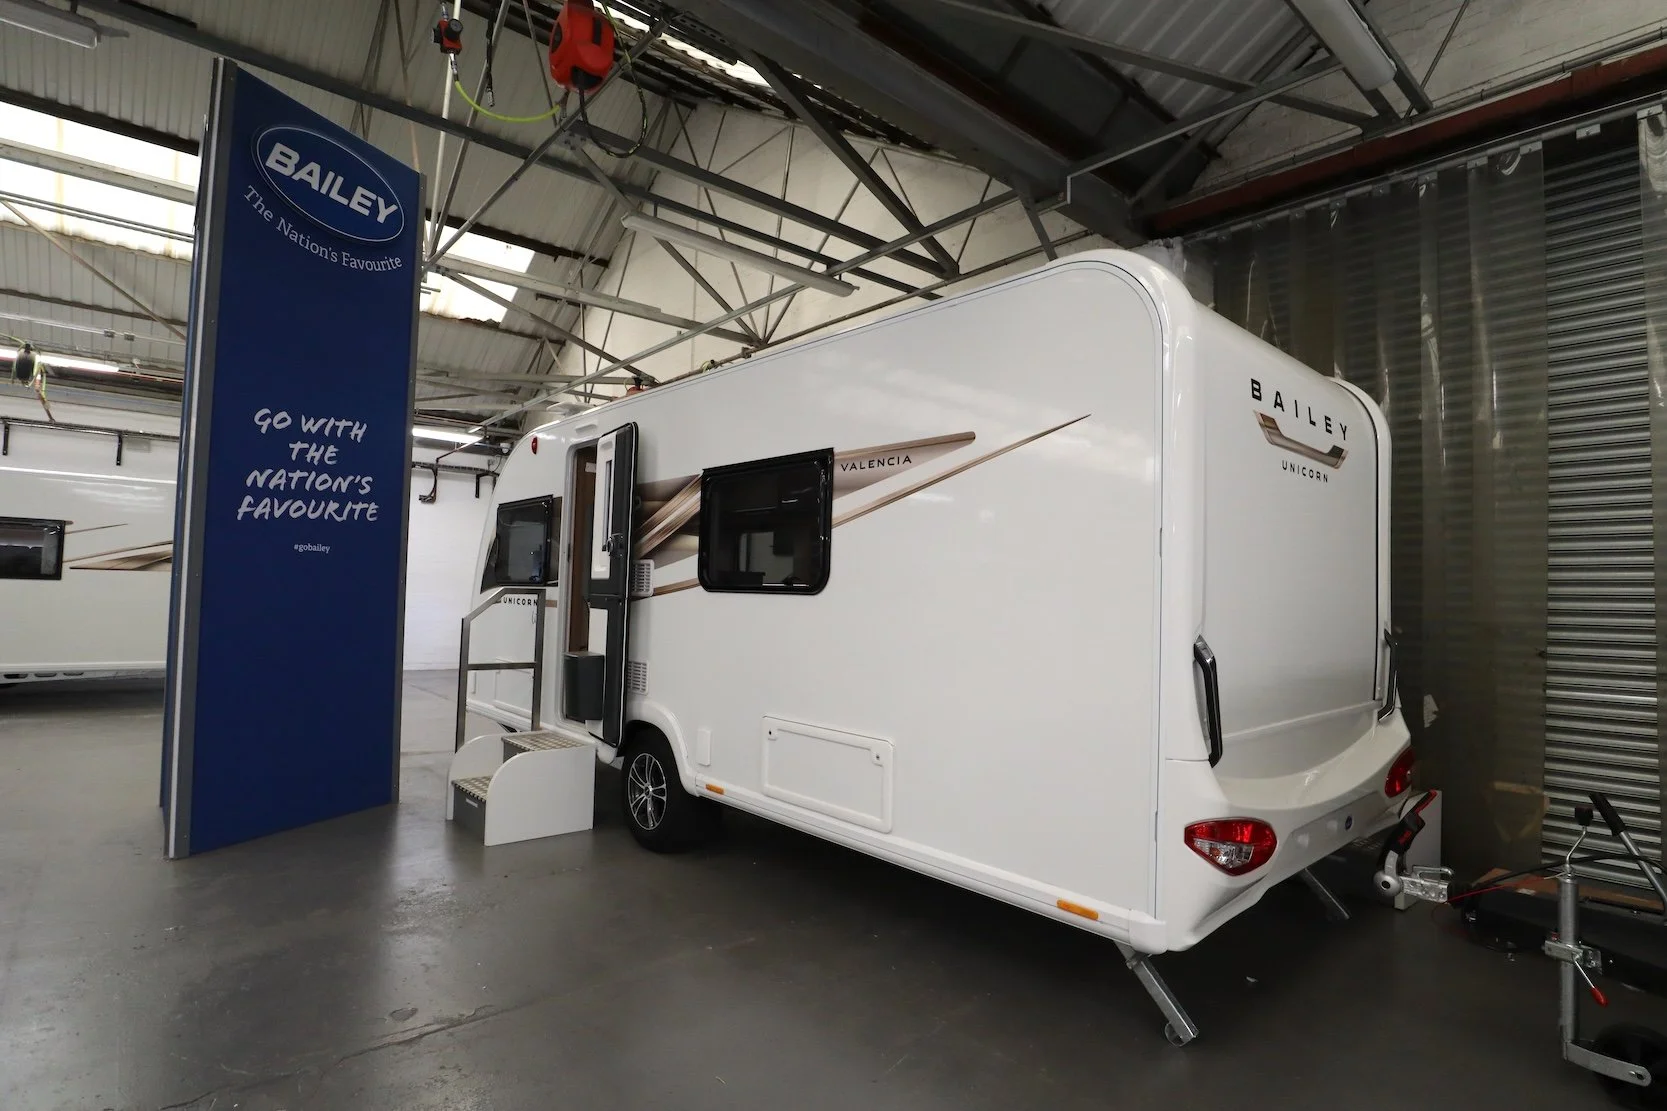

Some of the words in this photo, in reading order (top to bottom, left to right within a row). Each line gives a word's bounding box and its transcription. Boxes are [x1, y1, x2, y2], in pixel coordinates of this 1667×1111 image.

[265, 142, 399, 224] BAILEY
[244, 185, 274, 222] The
[276, 216, 338, 263] Nation's
[341, 251, 403, 272] Favourite
[1250, 378, 1347, 441] BAILEY
[254, 408, 292, 434] GO
[301, 414, 367, 443] WITH
[289, 440, 340, 465] THE
[840, 454, 912, 472] VALENCIA
[245, 468, 373, 495] NATION'S
[1281, 459, 1329, 483] UNICORN
[236, 495, 380, 522] FAVOURITE
[293, 543, 331, 554] #gobailey
[503, 597, 538, 606] UNICORN
